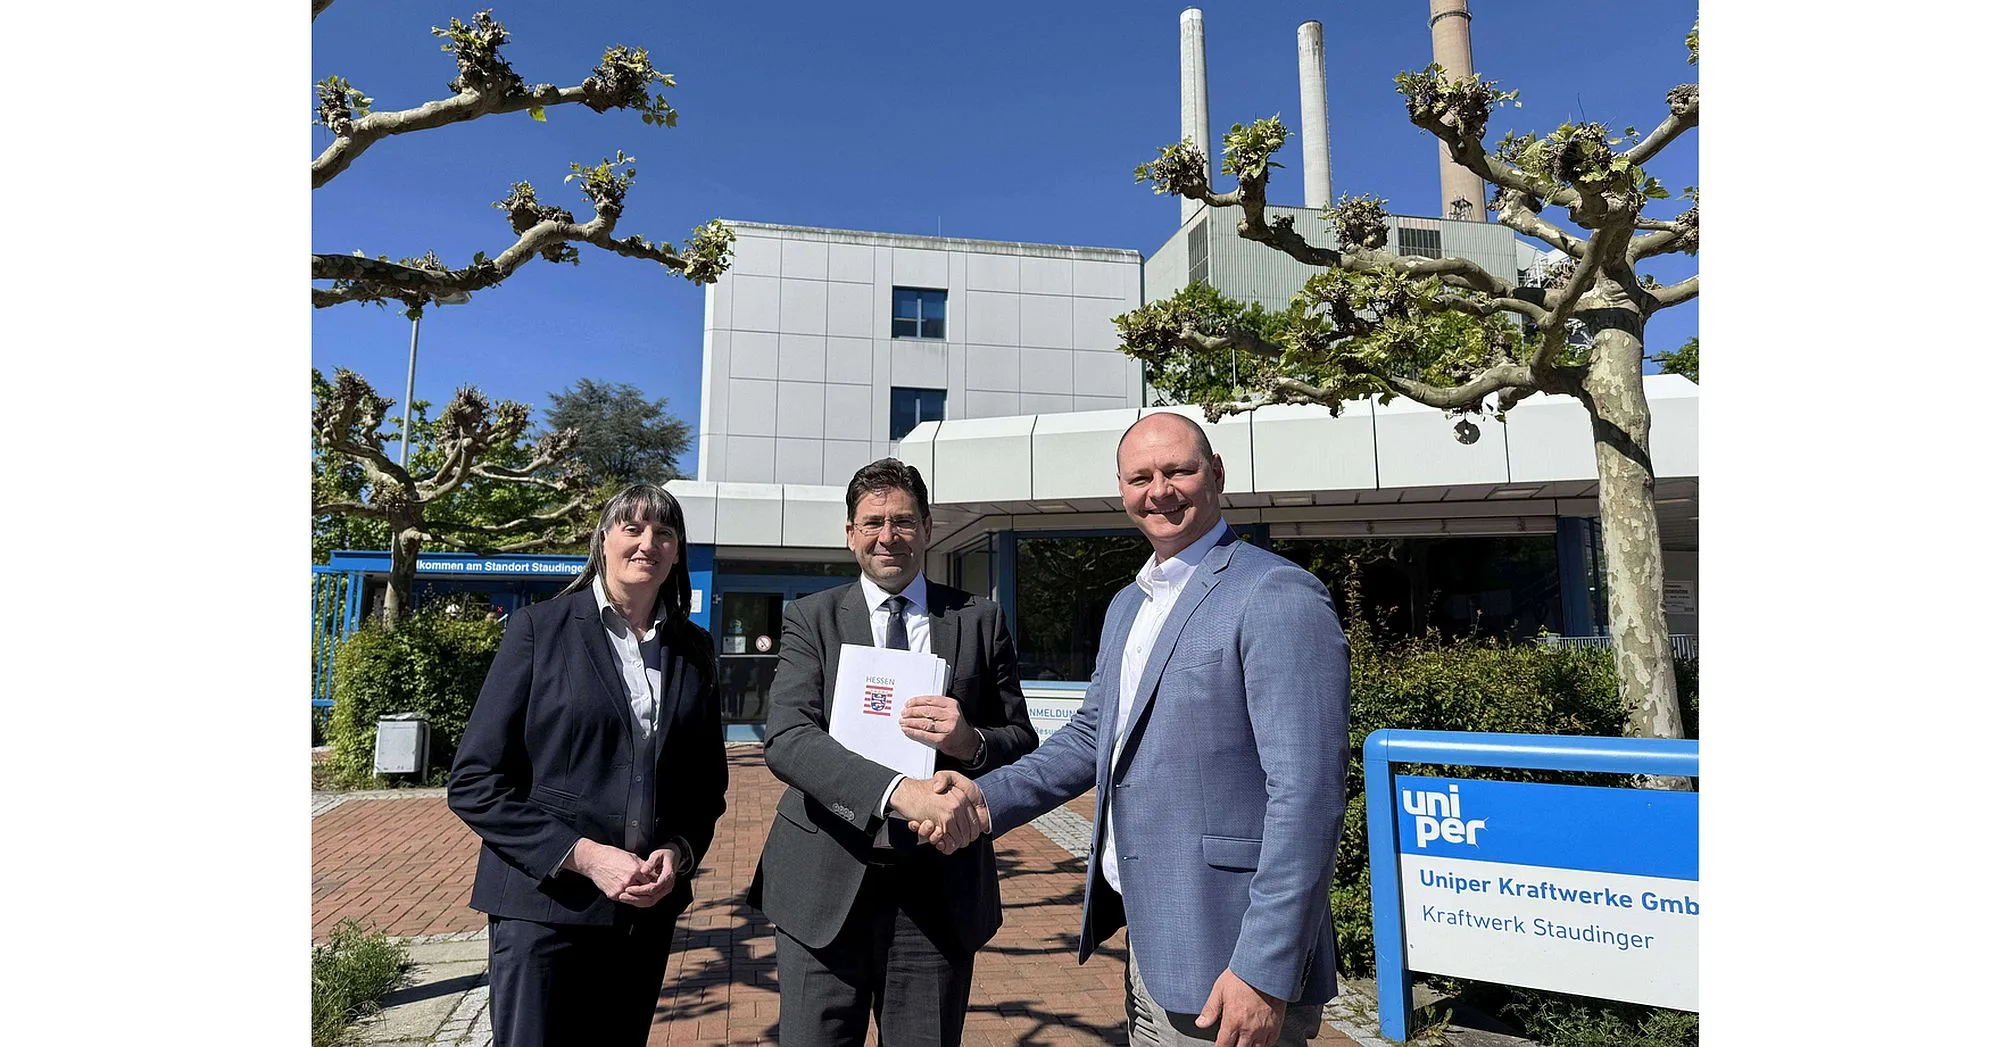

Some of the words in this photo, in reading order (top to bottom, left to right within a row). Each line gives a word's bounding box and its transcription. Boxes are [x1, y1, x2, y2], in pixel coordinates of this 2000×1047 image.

[466, 562, 482, 571] am
[485, 561, 529, 572] Standort
[866, 676, 895, 685] HESSEN
[1420, 869, 1491, 894] Uniper
[1499, 877, 1632, 908] Kraftwerke
[1641, 892, 1699, 916] Gmb
[1422, 904, 1526, 934] Kraftwerk
[1533, 918, 1654, 950] Staudinger
